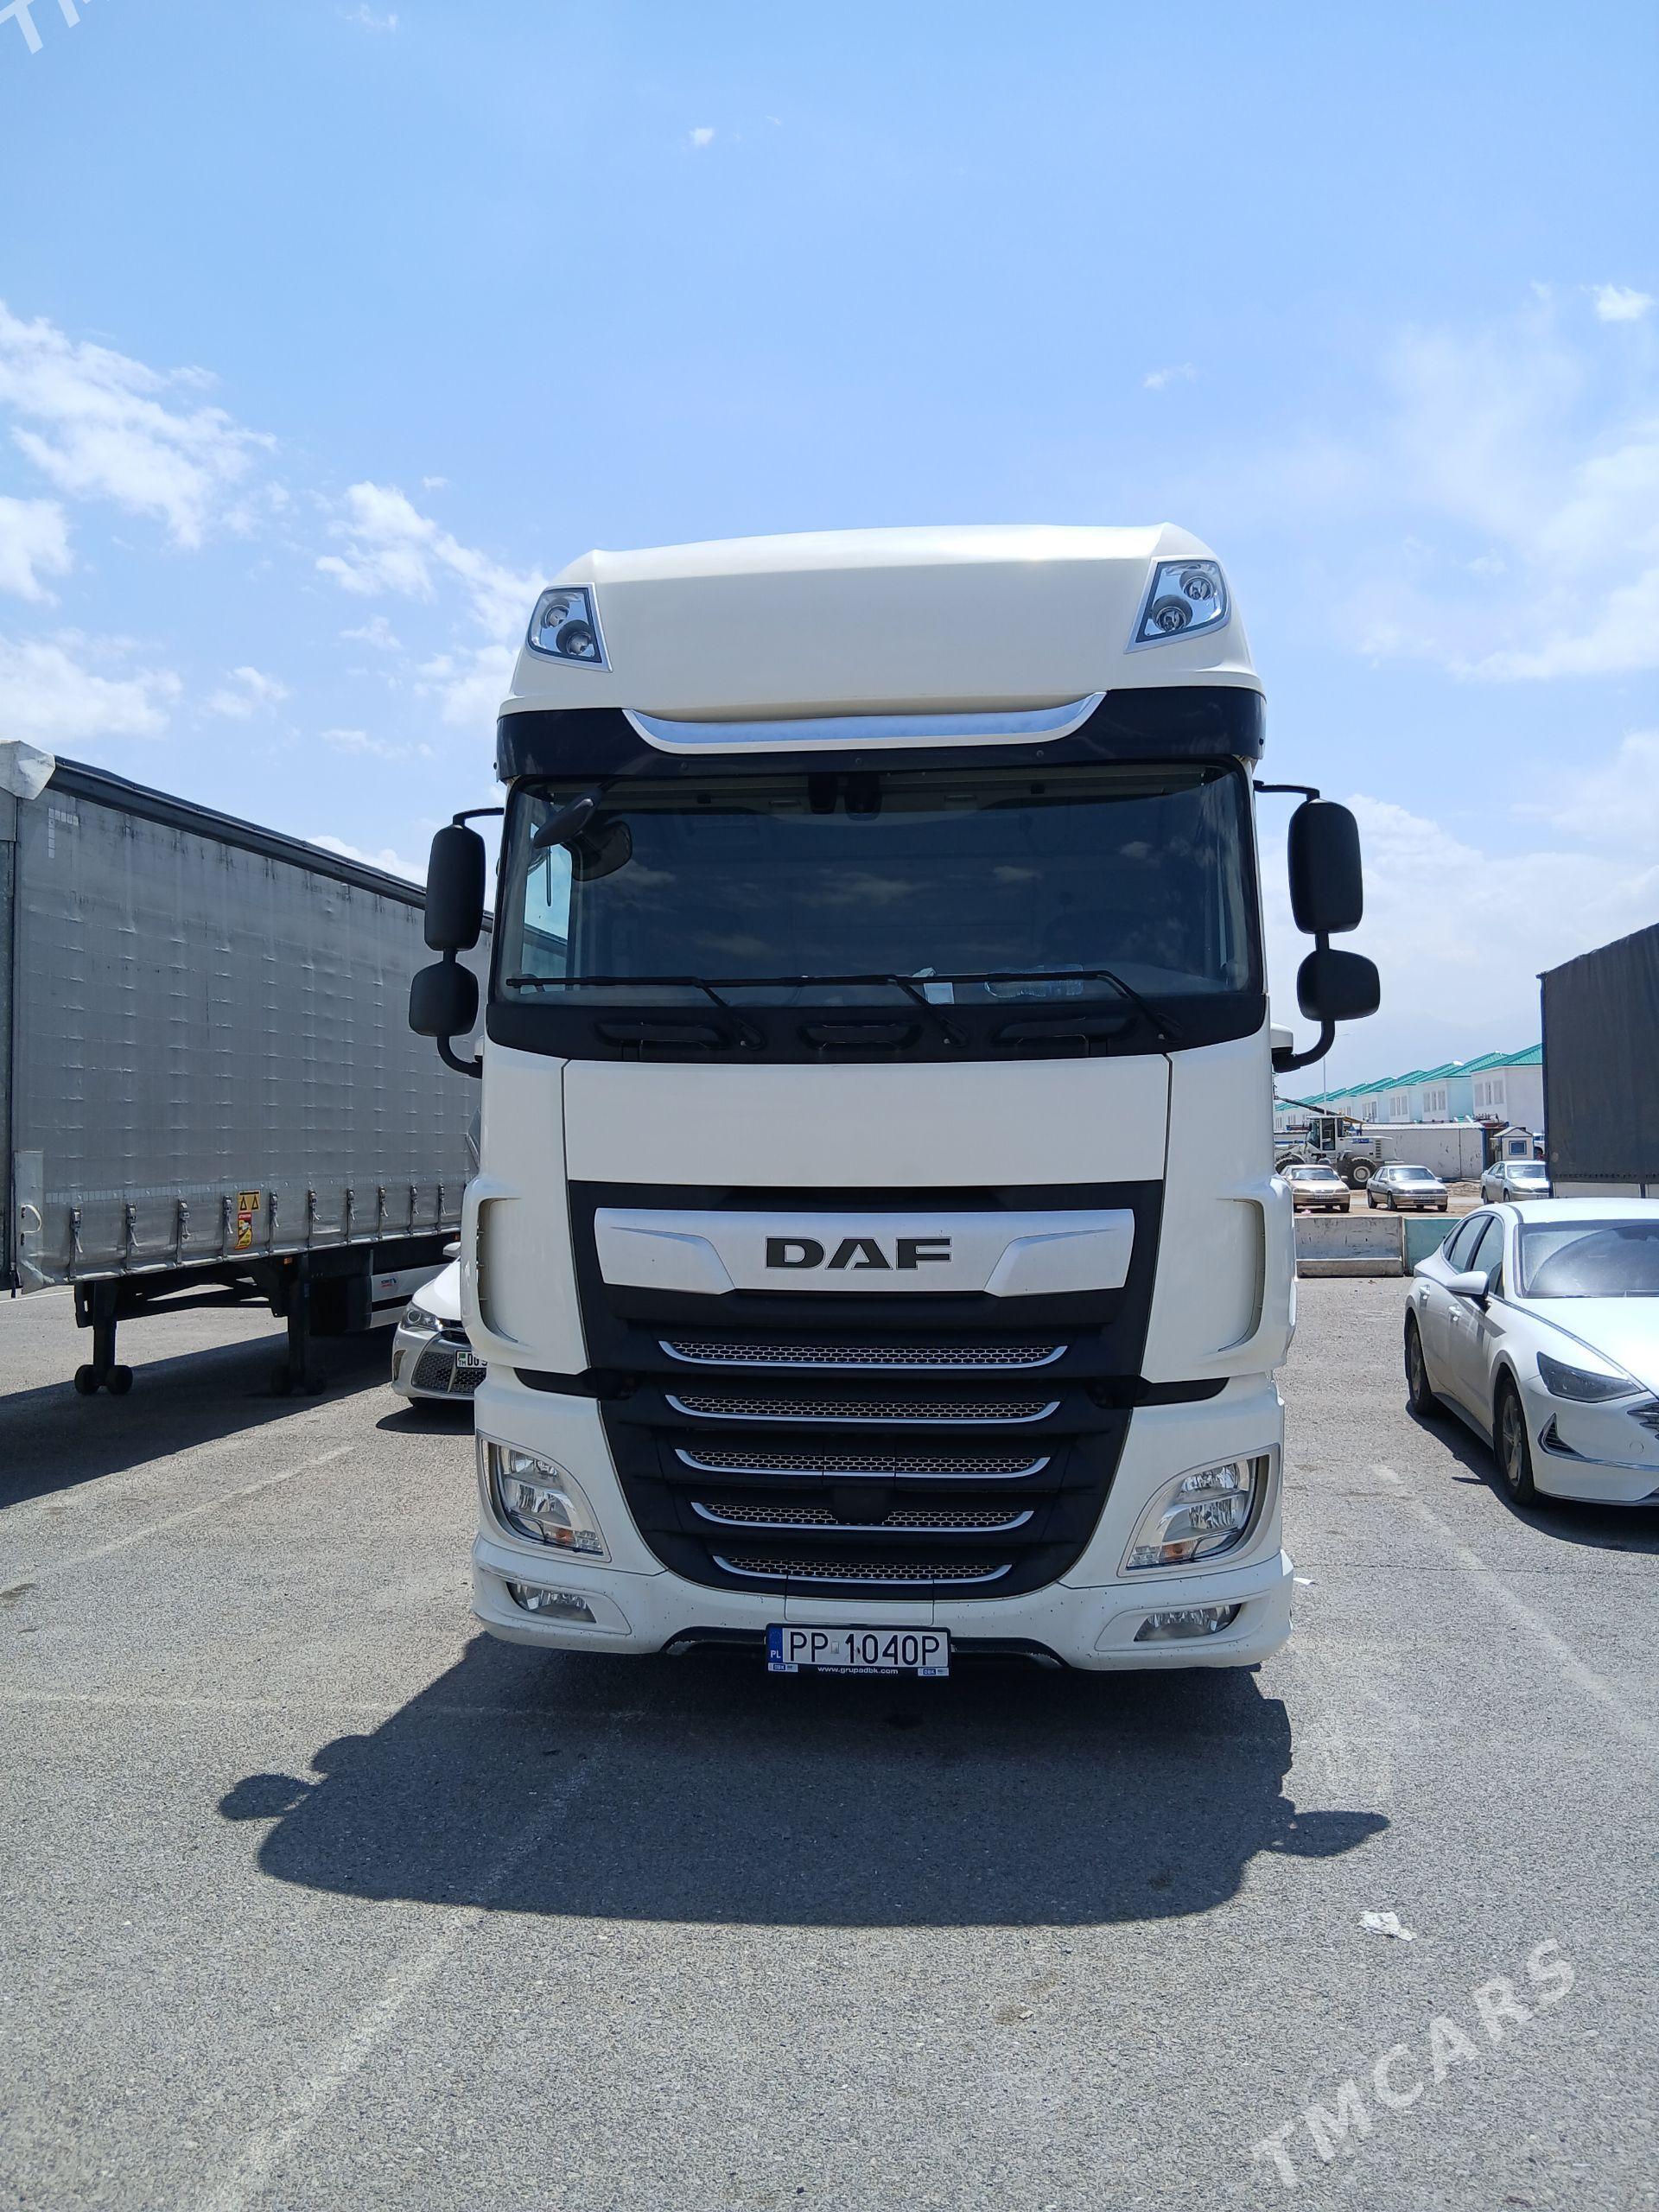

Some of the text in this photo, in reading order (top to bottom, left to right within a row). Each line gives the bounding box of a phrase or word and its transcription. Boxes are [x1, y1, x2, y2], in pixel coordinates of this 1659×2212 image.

[765, 1236, 952, 1270] DAF
[770, 1649, 782, 1659] PL
[790, 1631, 940, 1666] PP 1040P
[817, 1666, 899, 1675] www.grupadbk.com
